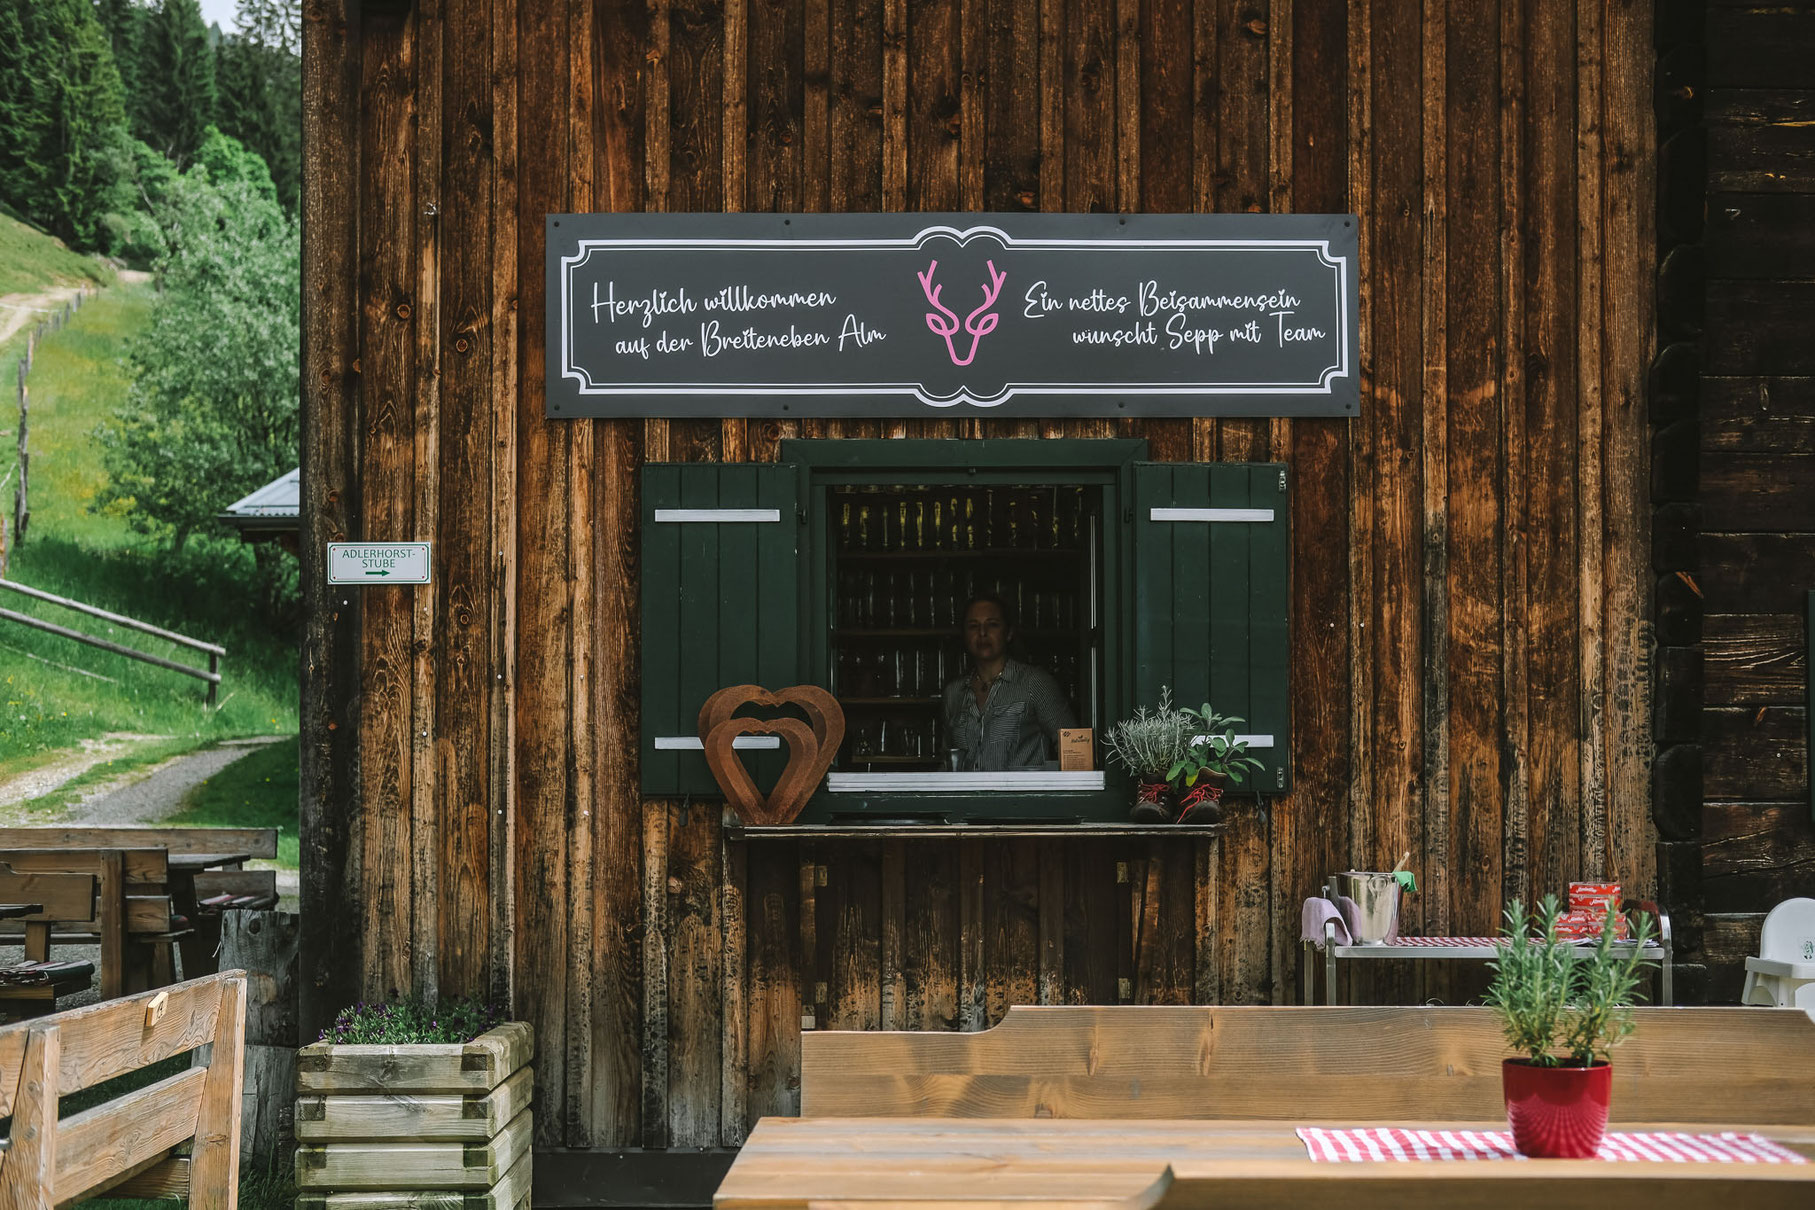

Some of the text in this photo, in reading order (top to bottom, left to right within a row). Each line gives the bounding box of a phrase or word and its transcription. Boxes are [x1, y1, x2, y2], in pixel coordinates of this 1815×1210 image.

[591, 281, 836, 328] Herzlich willkommen
[1024, 280, 1300, 318] Ein nettes Beisammensein
[616, 314, 886, 359] auf der Breiteneben Alm
[1166, 313, 1224, 354] Sepp
[1230, 320, 1261, 343] mit
[1269, 311, 1326, 348] Team
[343, 549, 415, 558] ADLERHORST-
[362, 559, 395, 568] STUBE
